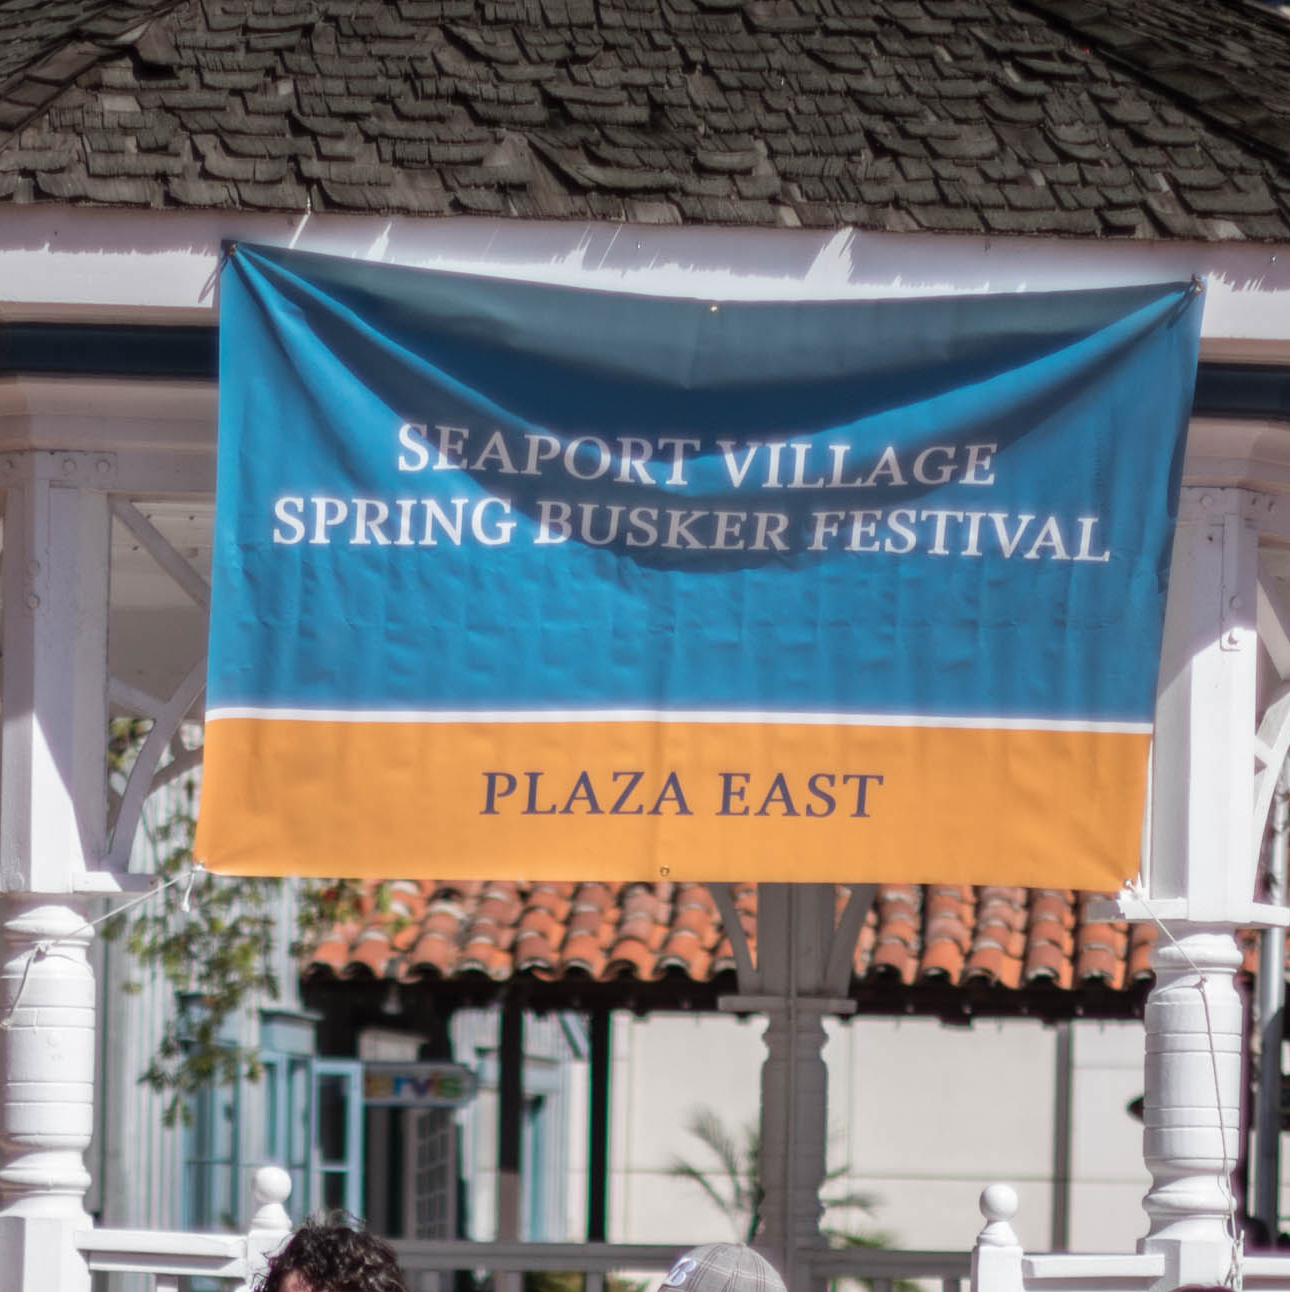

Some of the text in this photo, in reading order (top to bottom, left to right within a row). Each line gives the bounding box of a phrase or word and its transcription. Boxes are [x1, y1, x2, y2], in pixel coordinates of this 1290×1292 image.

[397, 421, 997, 489] SEAPORT VILLAGE
[272, 494, 1111, 563] SPRING BUSKER FESTIVAL
[479, 771, 884, 818] PLAZA EAST
